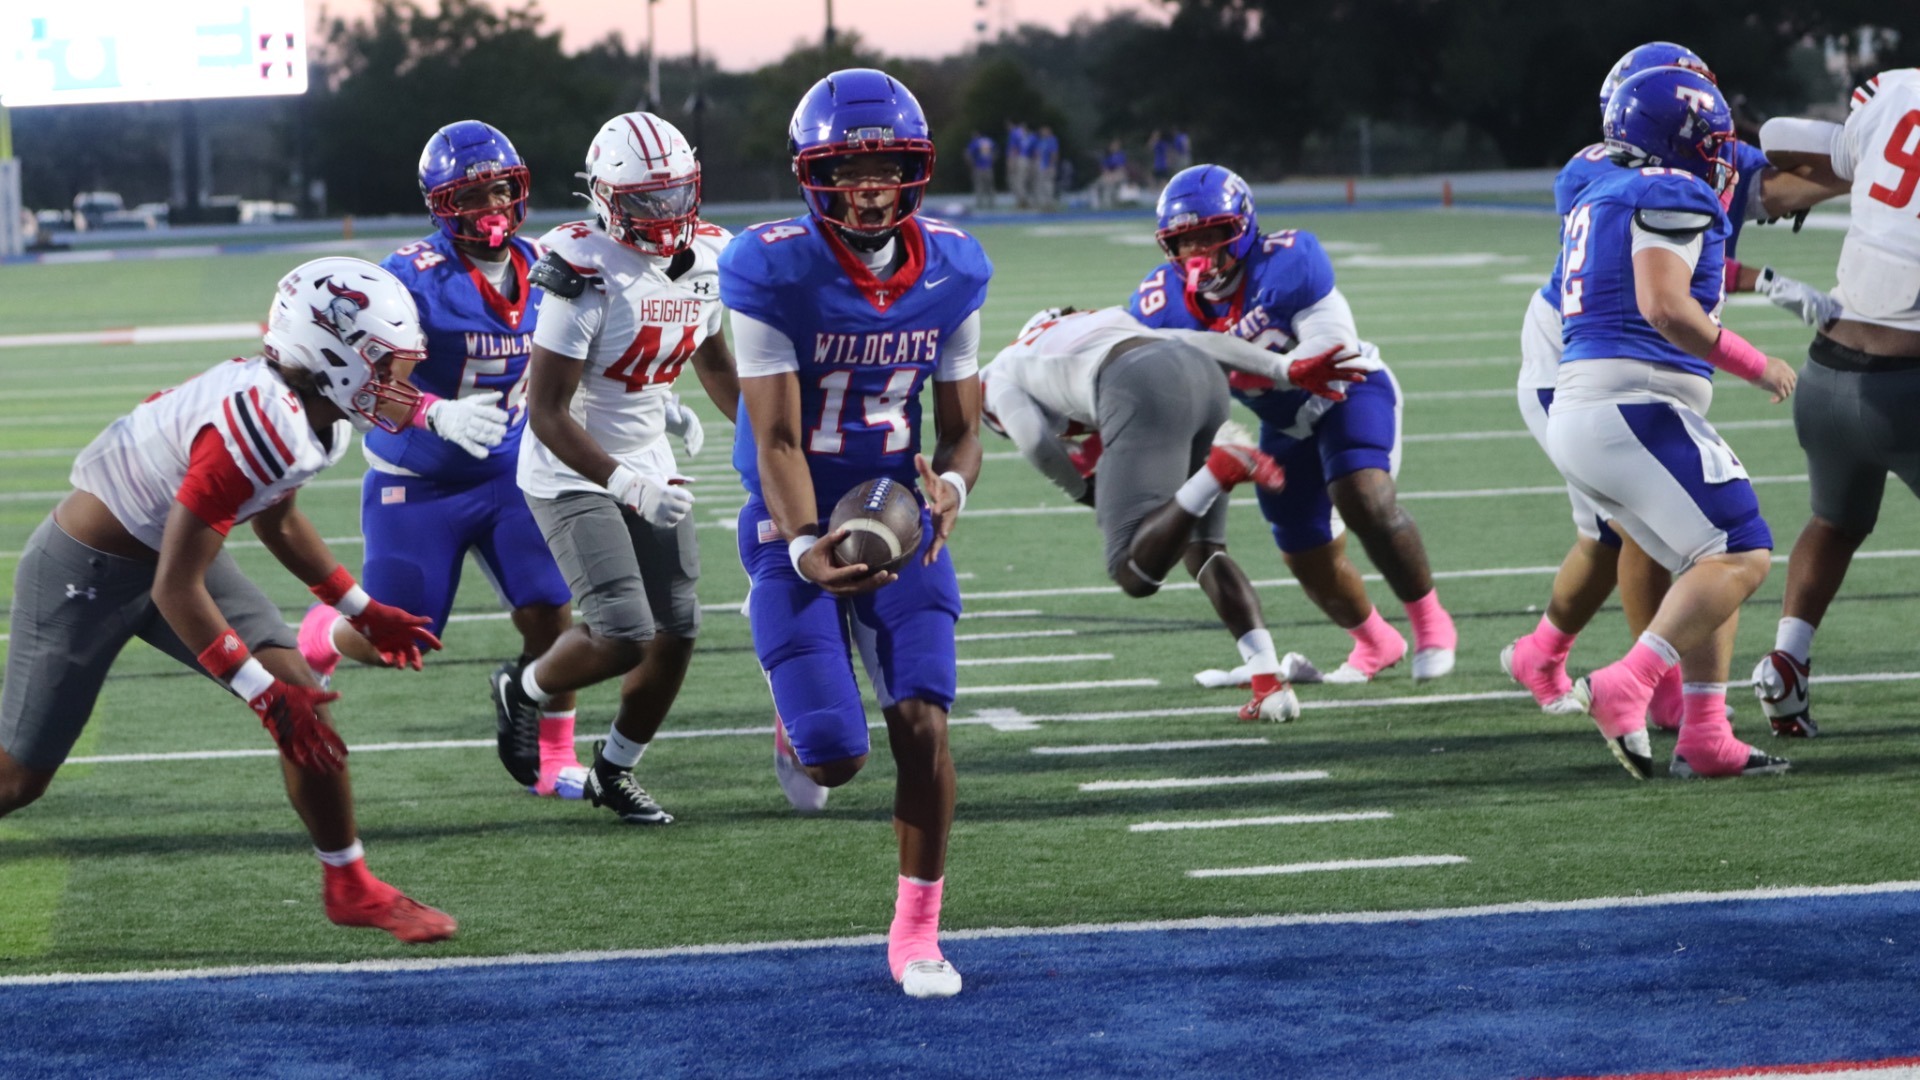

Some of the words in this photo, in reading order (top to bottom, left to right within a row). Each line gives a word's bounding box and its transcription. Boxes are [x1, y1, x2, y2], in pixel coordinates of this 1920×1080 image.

[875, 289, 890, 307] T
[1138, 269, 1167, 317] 79
[509, 310, 519, 326] T
[640, 299, 702, 323] HEIGHTS
[464, 331, 533, 356] WILDCA
[602, 324, 700, 394] 44
[812, 328, 941, 367] WILDCATS
[807, 367, 921, 456] 14
